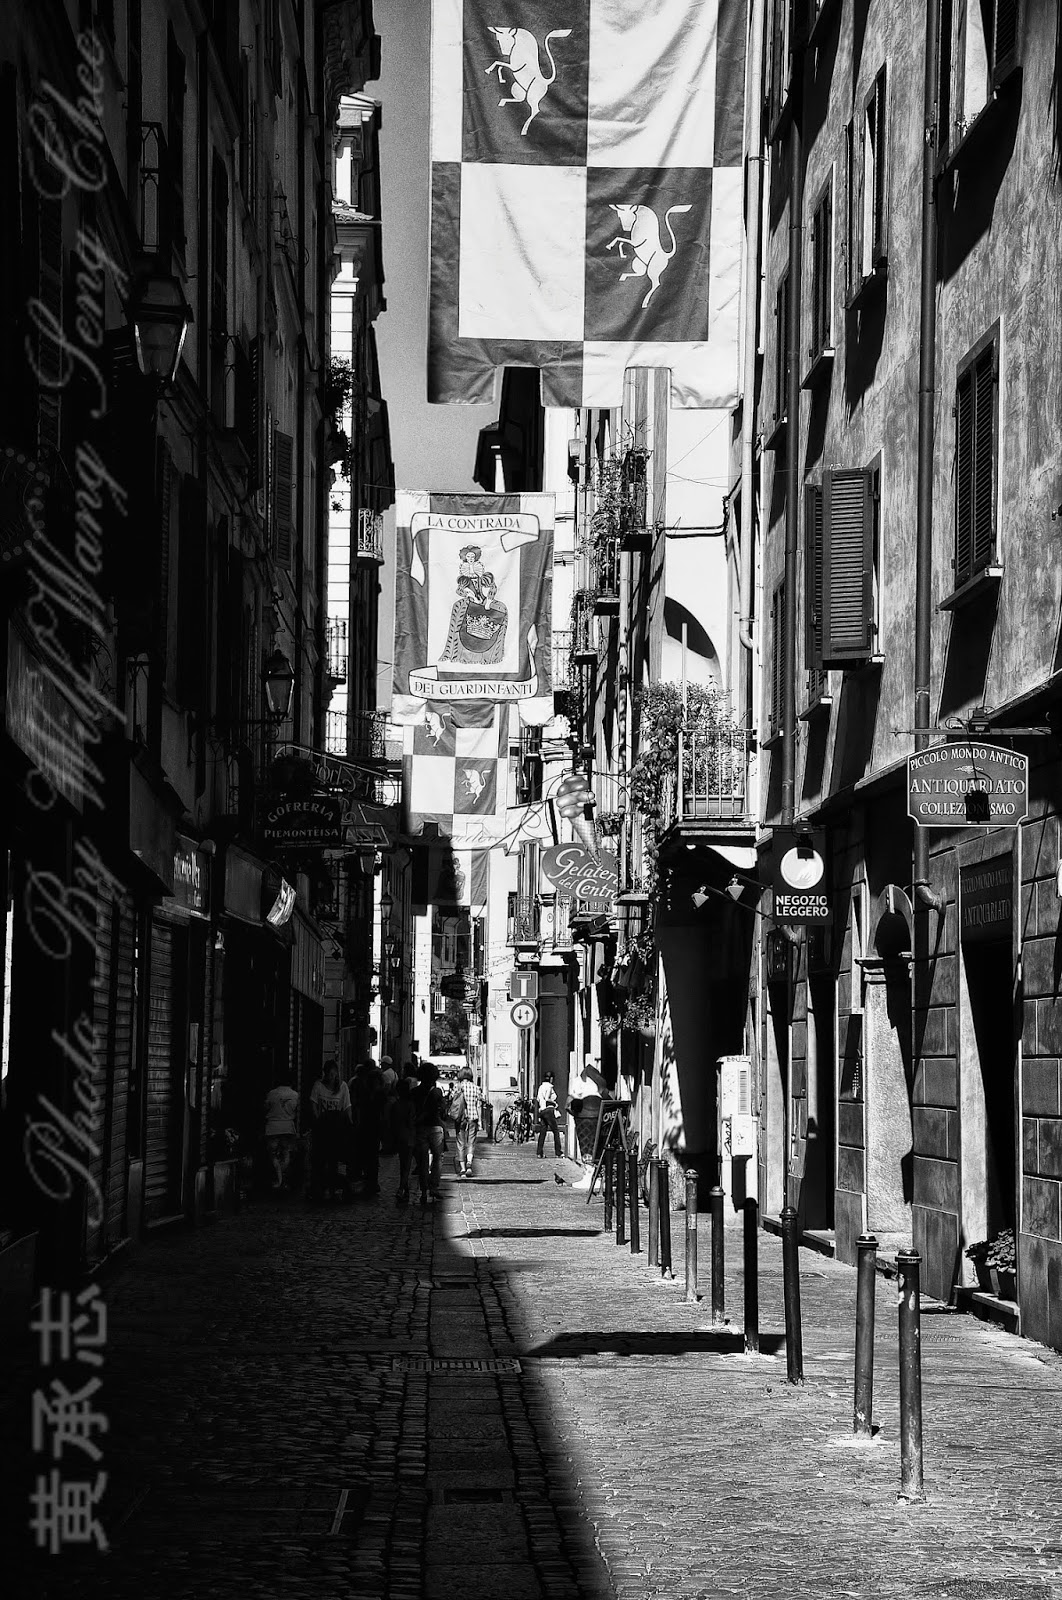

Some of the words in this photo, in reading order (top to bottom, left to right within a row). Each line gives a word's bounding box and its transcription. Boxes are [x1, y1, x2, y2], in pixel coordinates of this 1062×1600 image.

[428, 516, 443, 527] LA
[448, 517, 520, 529] CONTRADA
[415, 682, 434, 695] DEI
[440, 683, 532, 695] GUARDINFANTI
[910, 751, 948, 771] PICCOLO
[951, 748, 987, 760] MONDO
[989, 750, 1026, 771] ANTICO
[910, 779, 1025, 797] ANTIQUARIATO
[267, 801, 334, 823] GOFRERIA
[919, 802, 1016, 815] COLLEZIONISMO
[558, 877, 579, 890] del
[776, 895, 827, 906] NEGOZIO
[776, 906, 829, 917] LEGGERO
